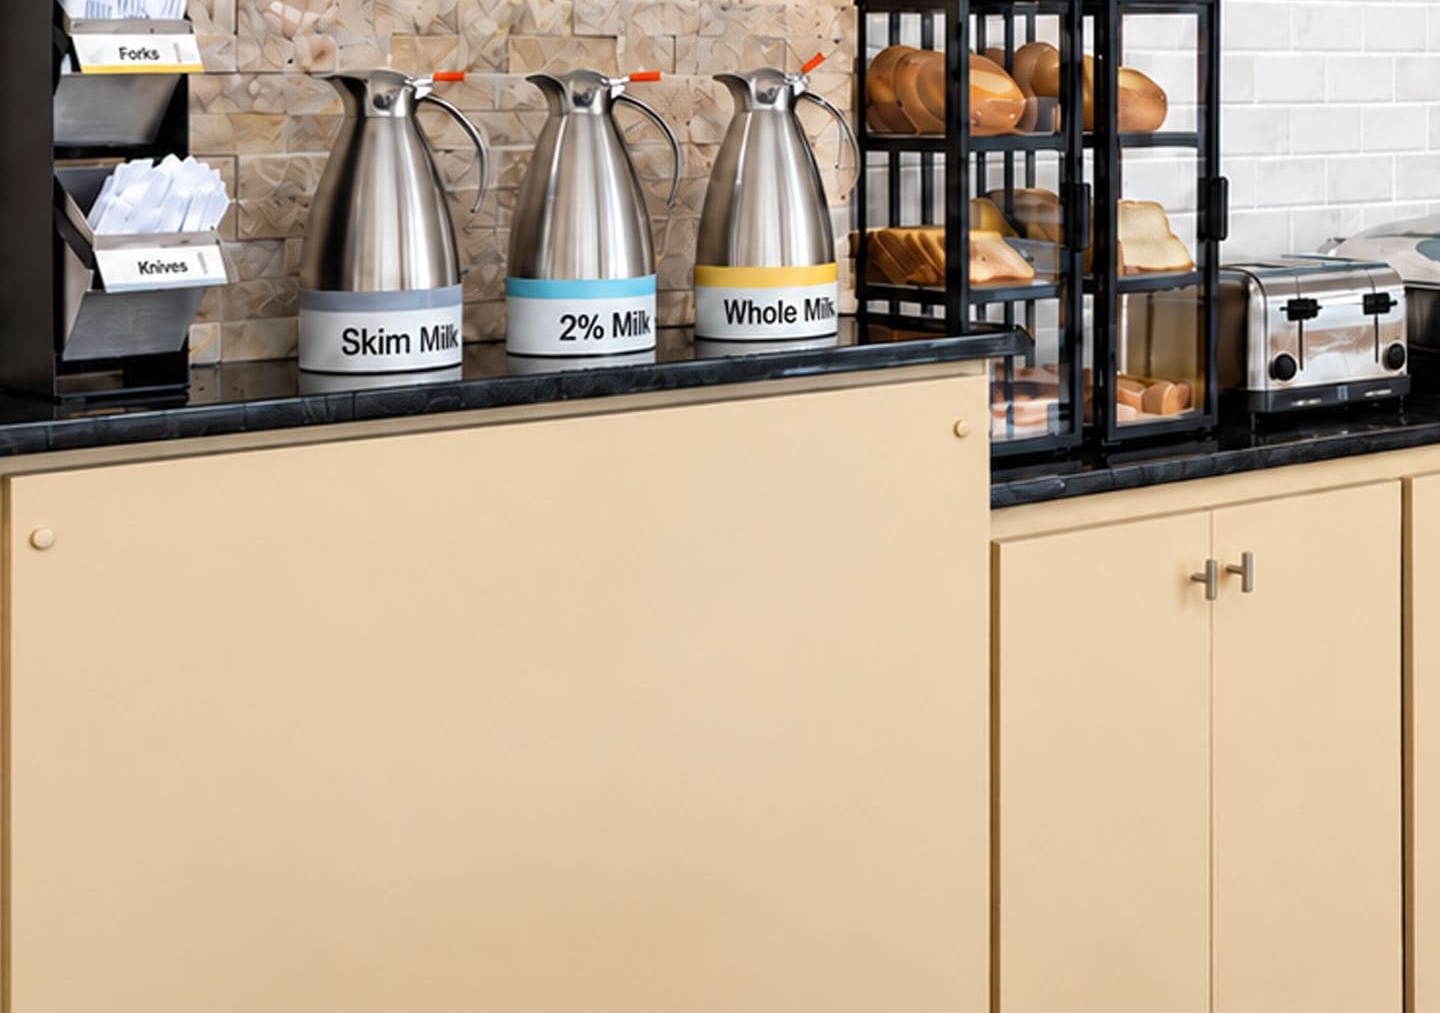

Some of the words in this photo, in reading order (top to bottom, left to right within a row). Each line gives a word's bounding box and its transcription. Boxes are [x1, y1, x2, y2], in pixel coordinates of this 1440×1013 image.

[118, 46, 161, 61] Forks
[137, 259, 189, 276] Knives
[723, 298, 798, 325] Whole
[559, 313, 605, 341] 2%
[612, 310, 652, 339] Milk
[341, 327, 411, 357] Skim
[420, 323, 459, 353] Milk
